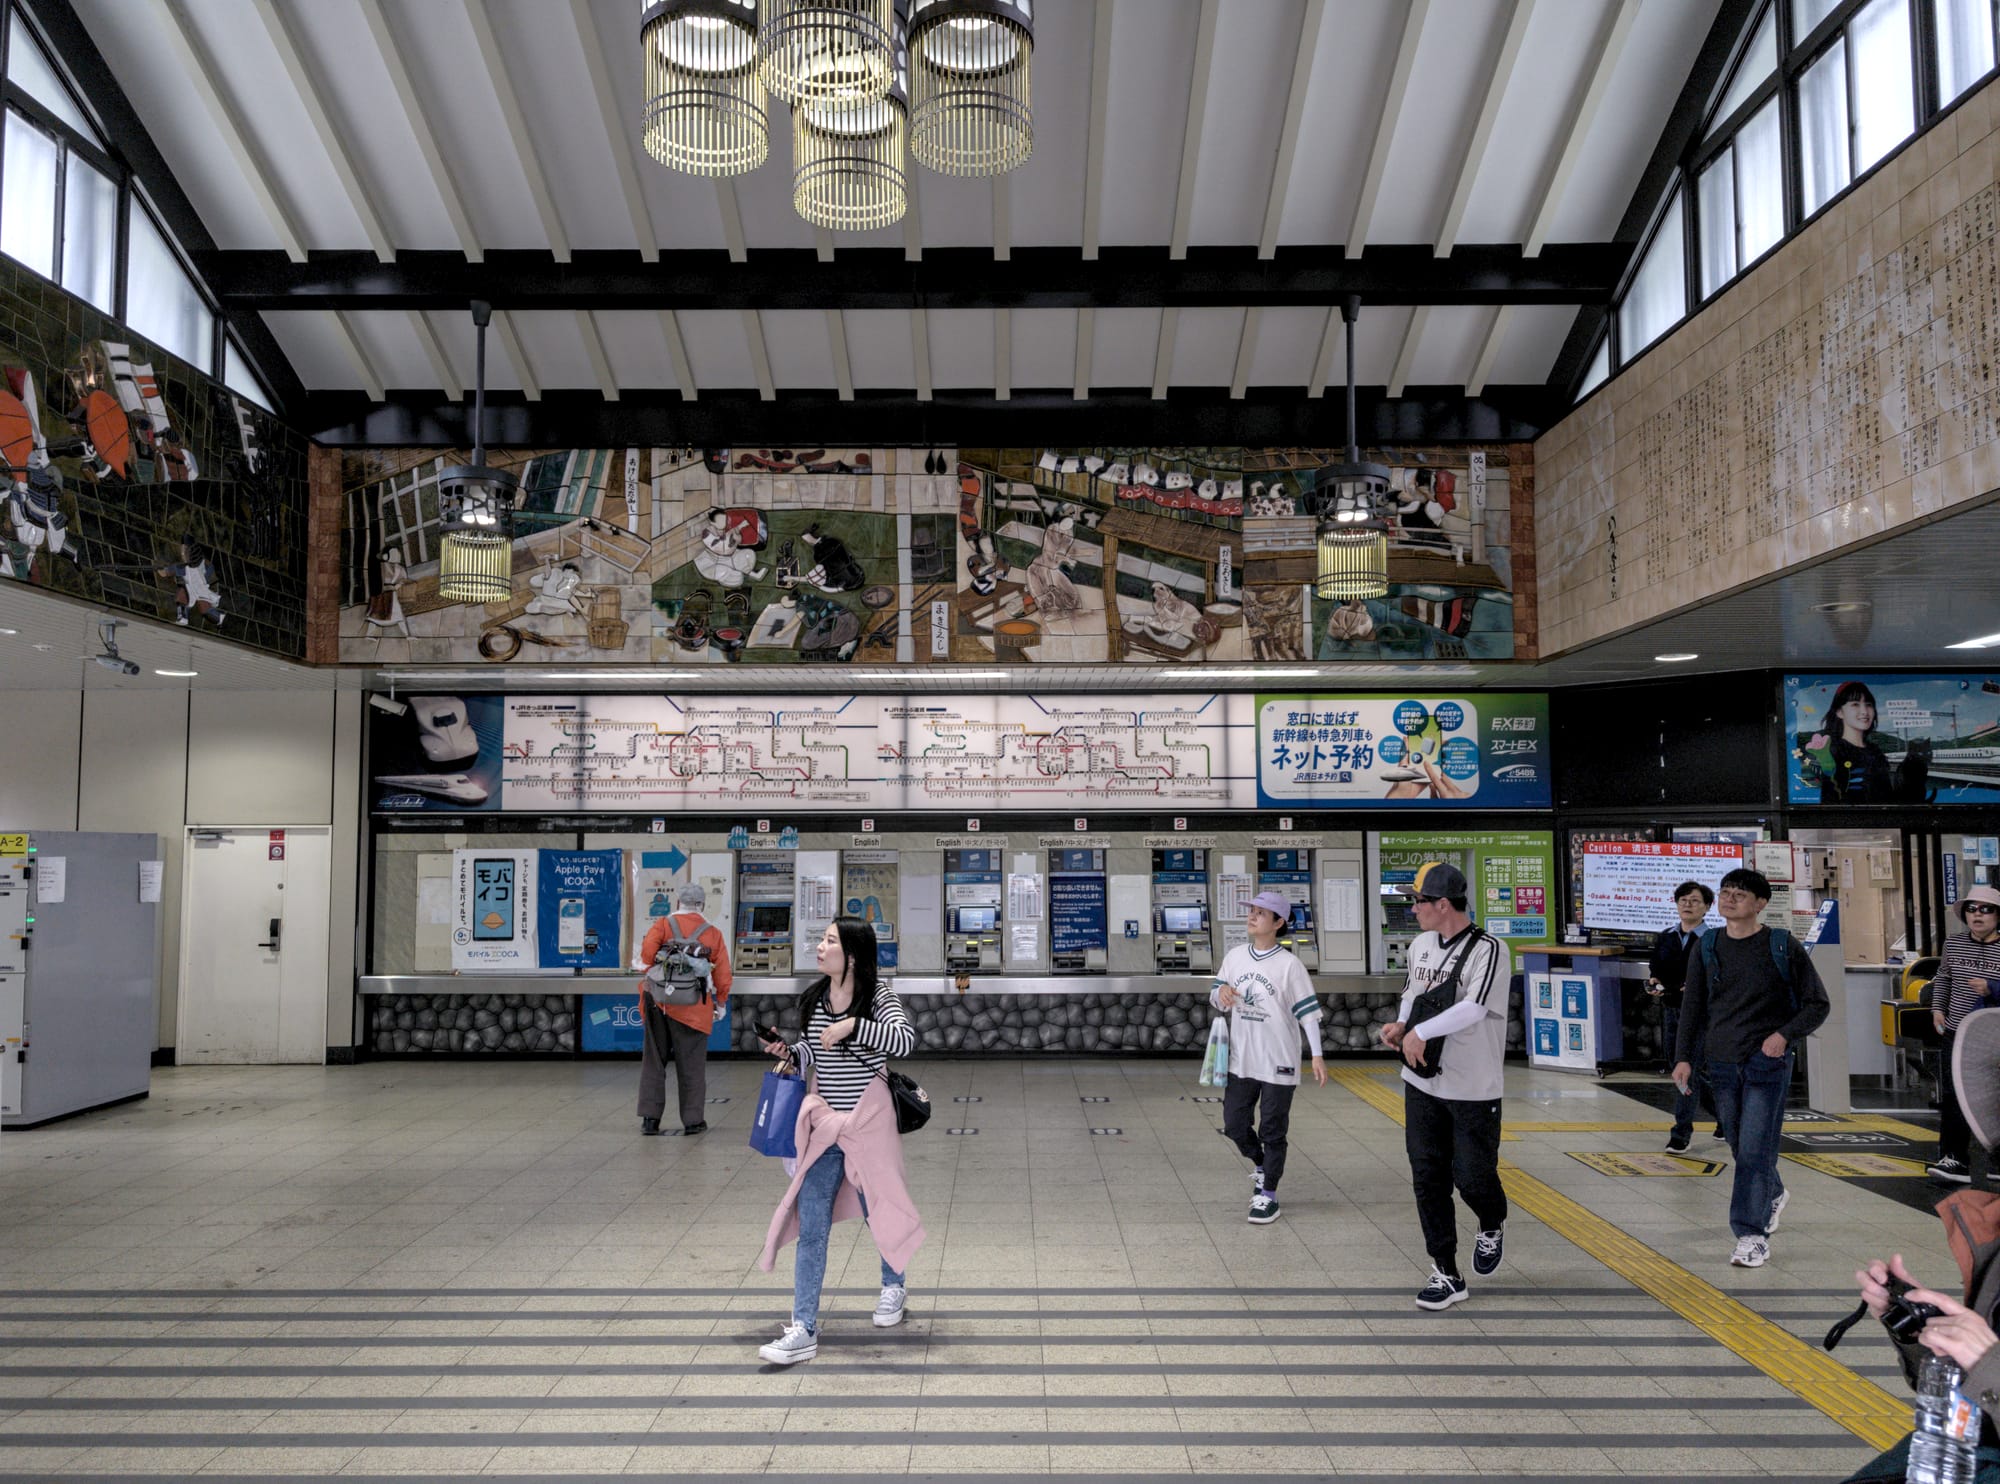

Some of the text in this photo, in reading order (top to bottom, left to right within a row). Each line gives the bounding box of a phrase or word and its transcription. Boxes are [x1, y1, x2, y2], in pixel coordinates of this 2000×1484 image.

[1287, 712, 1359, 726] 窓口に並ばず
[1272, 728, 1373, 742] 新幹線も特急列車も
[1491, 740, 1537, 750] スマートEX
[1270, 744, 1374, 770] ネット予約
[1294, 772, 1338, 781] JR西日本予約
[654, 822, 663, 831] 7
[969, 820, 978, 829] 4
[1076, 820, 1085, 829] 3
[1176, 819, 1184, 828] 2
[1283, 820, 1288, 828] 1
[0, 837, 23, 847] A-2
[854, 835, 880, 847] English
[936, 838, 961, 848] English
[1588, 844, 1622, 853] Caution
[1671, 844, 1691, 855] 양해
[1693, 845, 1736, 856] 바랍니다
[555, 865, 580, 874] Apple
[478, 869, 512, 883] モバ
[564, 877, 595, 886] ICOCA
[478, 887, 509, 901] イコ
[1234, 972, 1276, 996] UCKY BIRDS
